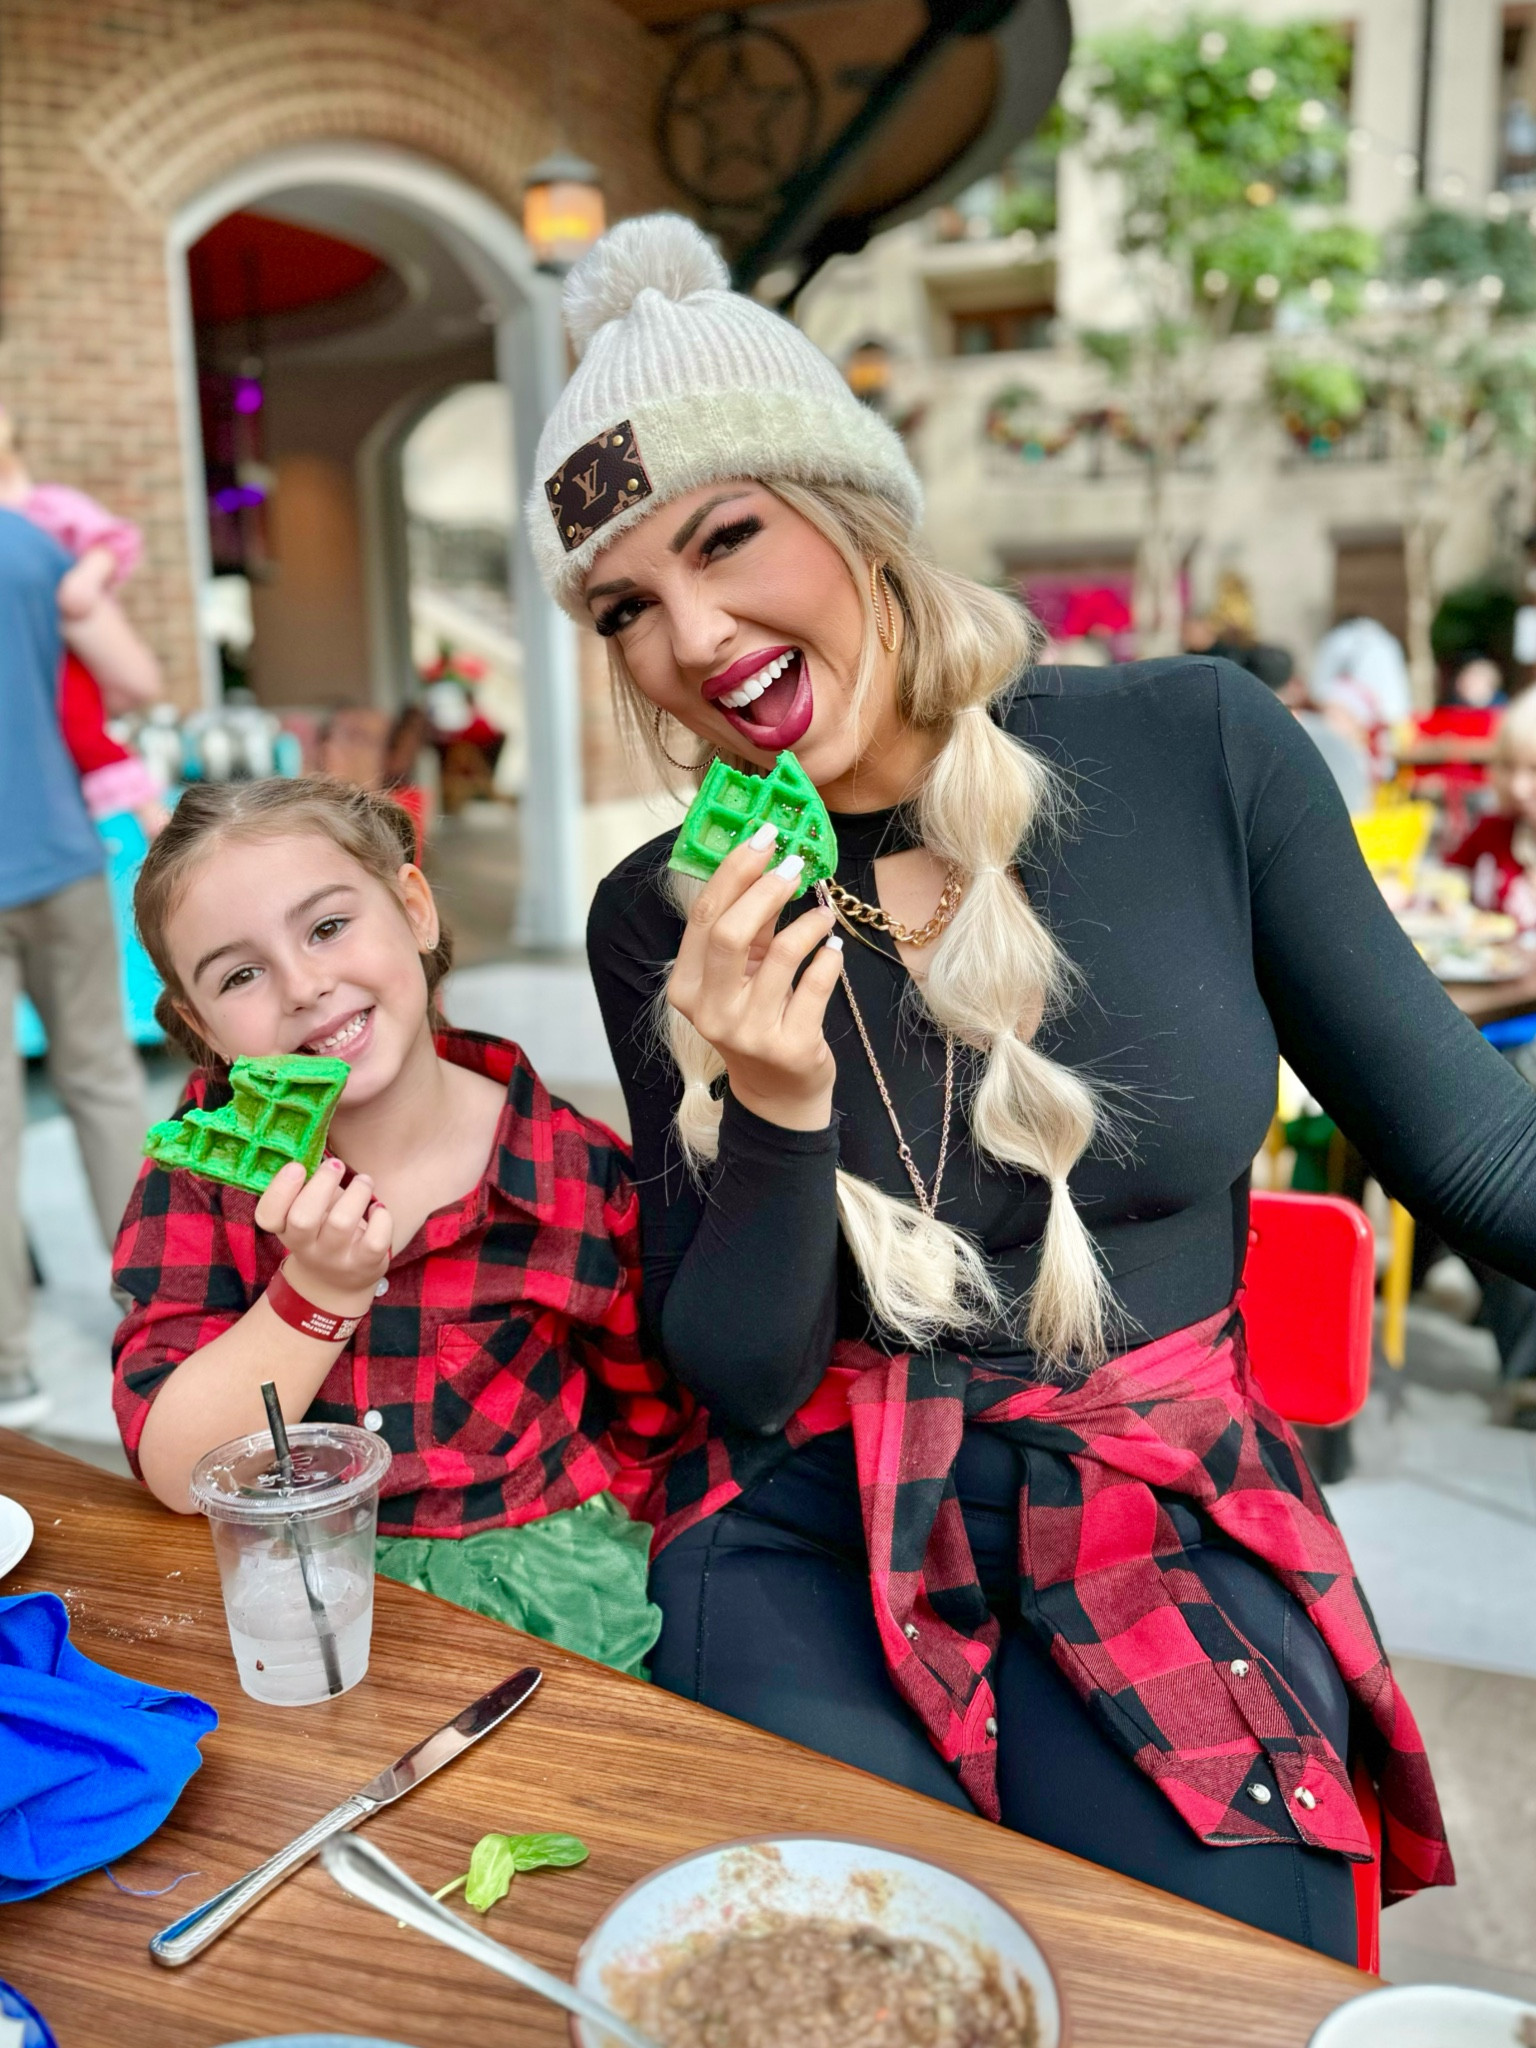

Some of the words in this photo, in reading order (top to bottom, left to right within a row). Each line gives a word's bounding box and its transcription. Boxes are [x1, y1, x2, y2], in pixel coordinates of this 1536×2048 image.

[312, 1313, 337, 1326] DETAILS
[301, 1320, 314, 1331] FOR
[313, 1326, 331, 1336] SCAN
